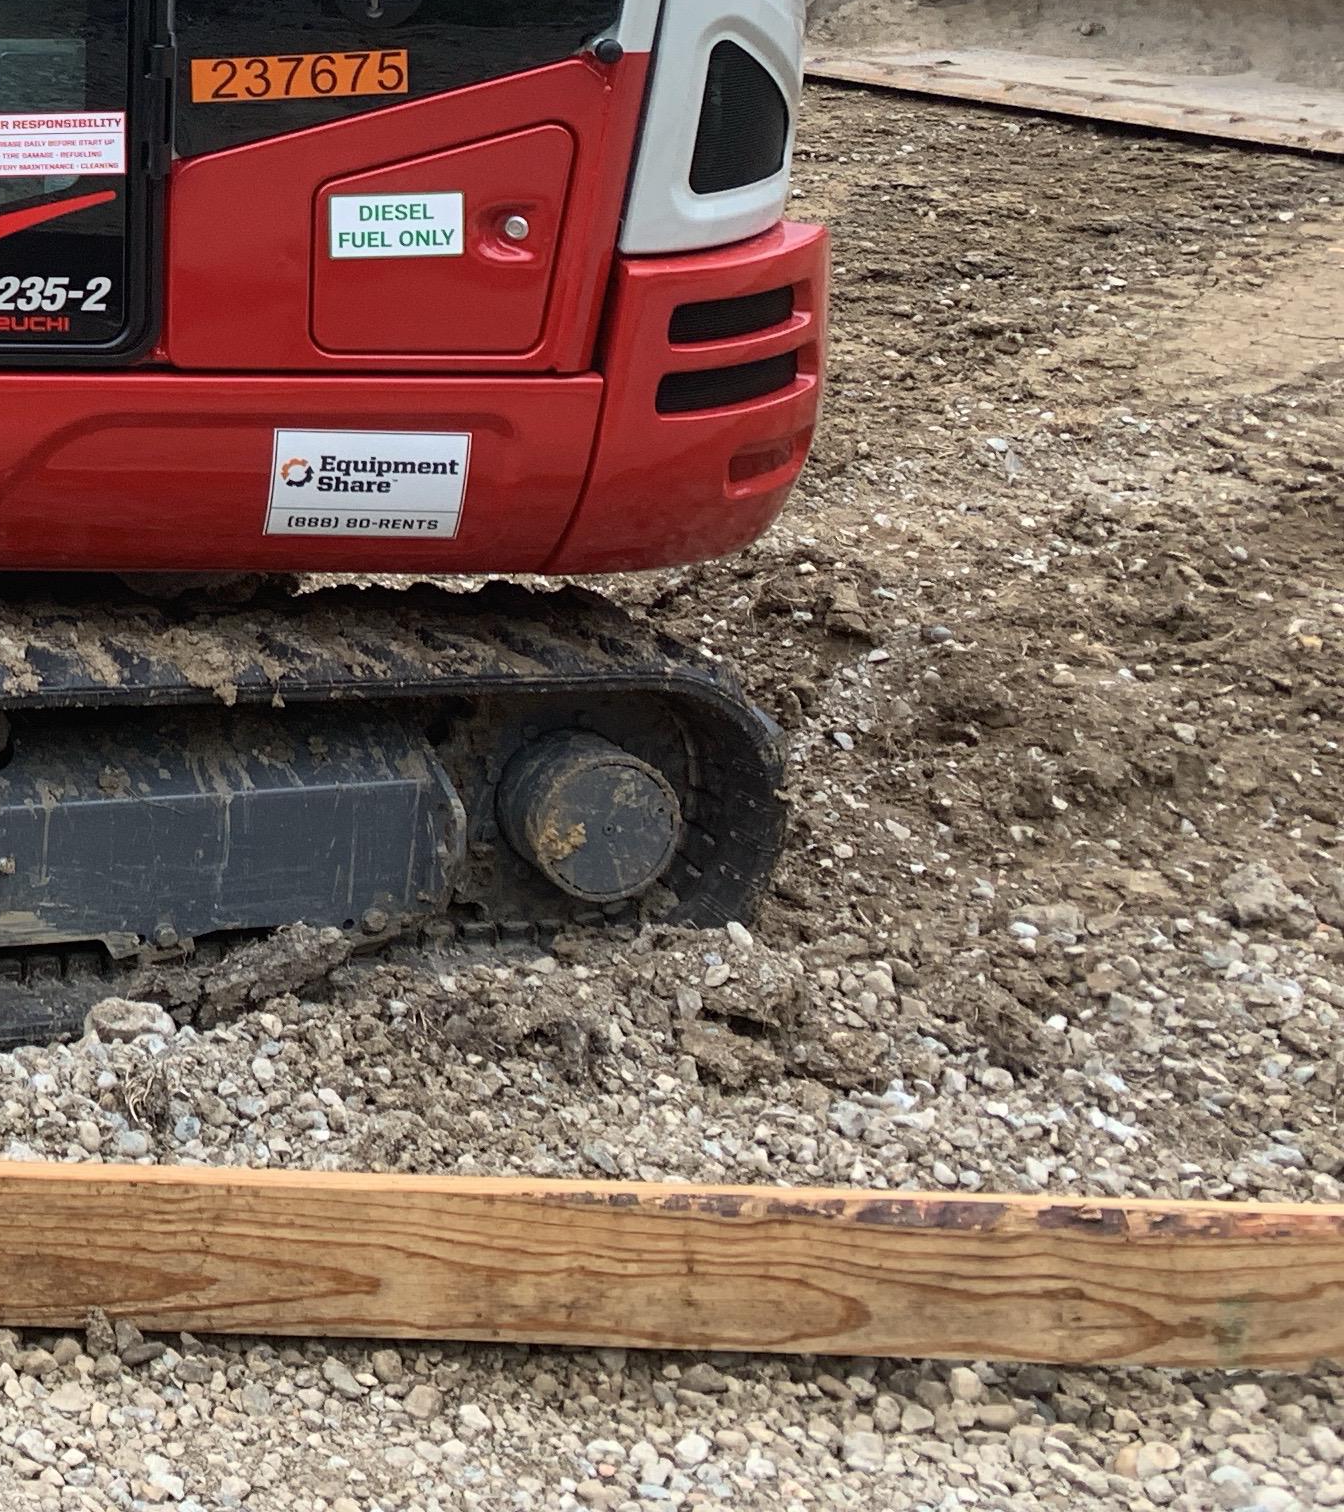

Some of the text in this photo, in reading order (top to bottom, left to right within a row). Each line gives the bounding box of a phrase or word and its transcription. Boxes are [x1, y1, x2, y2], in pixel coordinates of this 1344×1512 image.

[211, 51, 404, 99] 237675
[12, 118, 122, 130] RESPONSIBILITY
[358, 203, 435, 222] DIESEL
[338, 228, 455, 249] FUEL ONLY
[319, 455, 459, 477] Equipment
[316, 475, 392, 494] Share
[287, 515, 439, 531] (888) 80-RENTS
